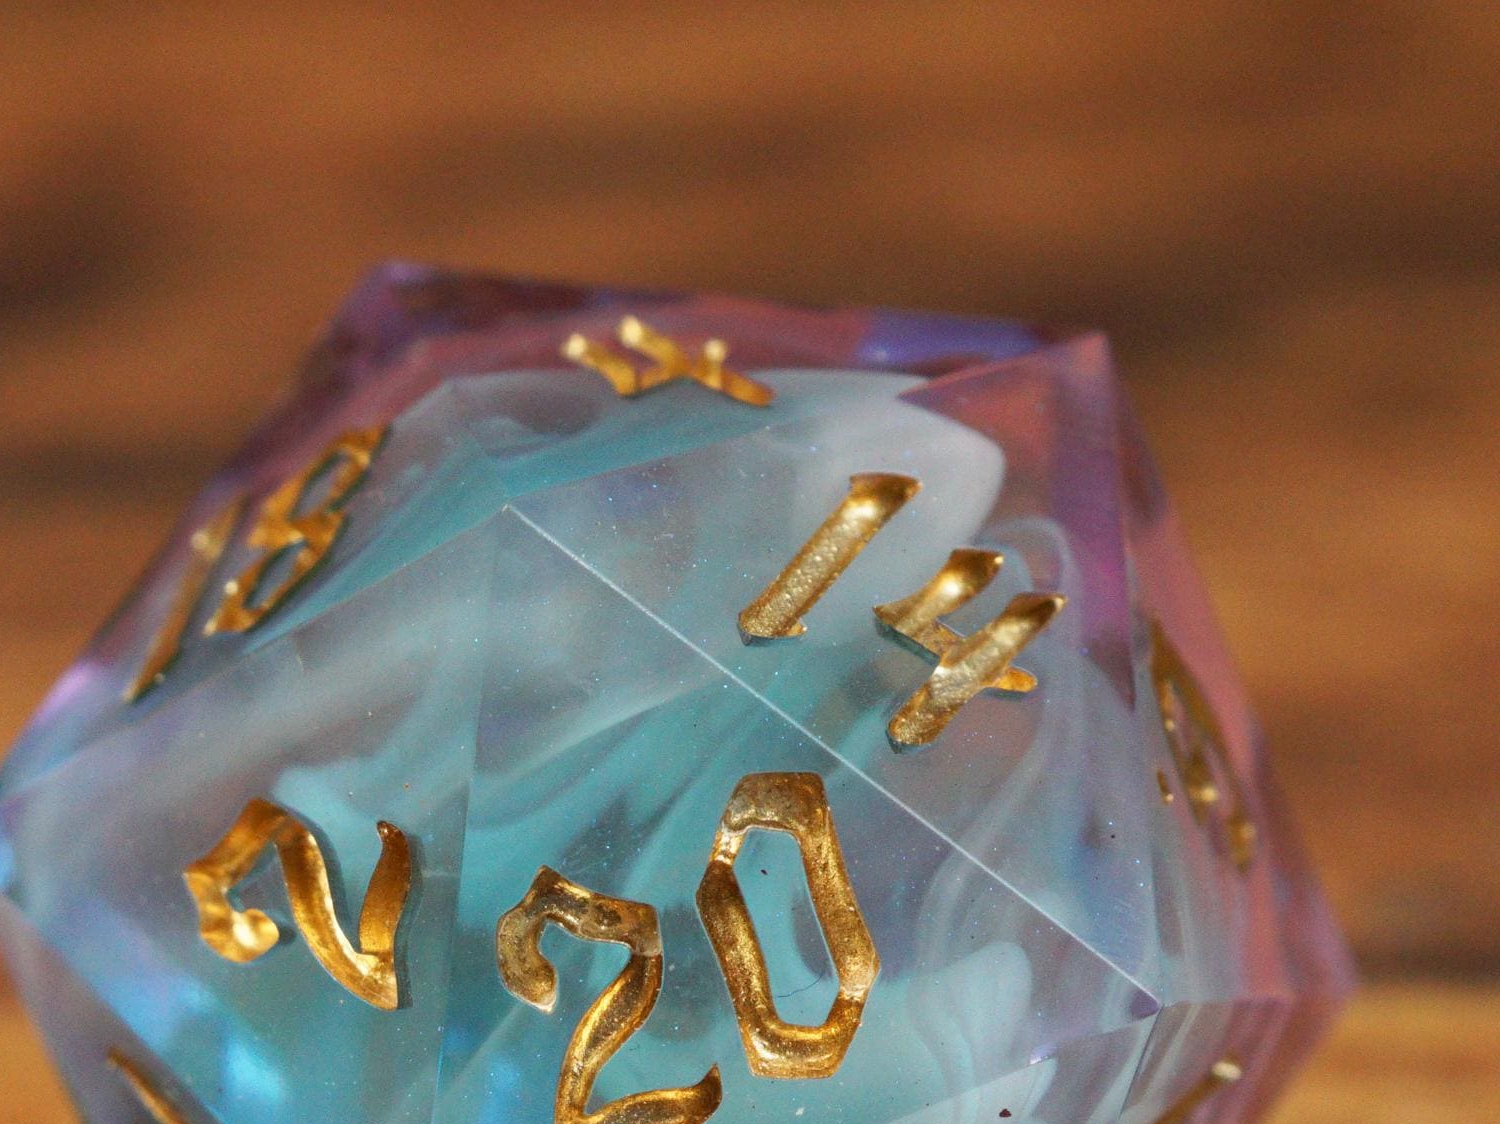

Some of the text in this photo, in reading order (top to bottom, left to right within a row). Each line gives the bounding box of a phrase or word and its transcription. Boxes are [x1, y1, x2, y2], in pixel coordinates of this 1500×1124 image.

[562, 315, 776, 407] 4
[123, 422, 392, 702] 18
[738, 472, 1066, 746] 14
[182, 798, 412, 1010] 2
